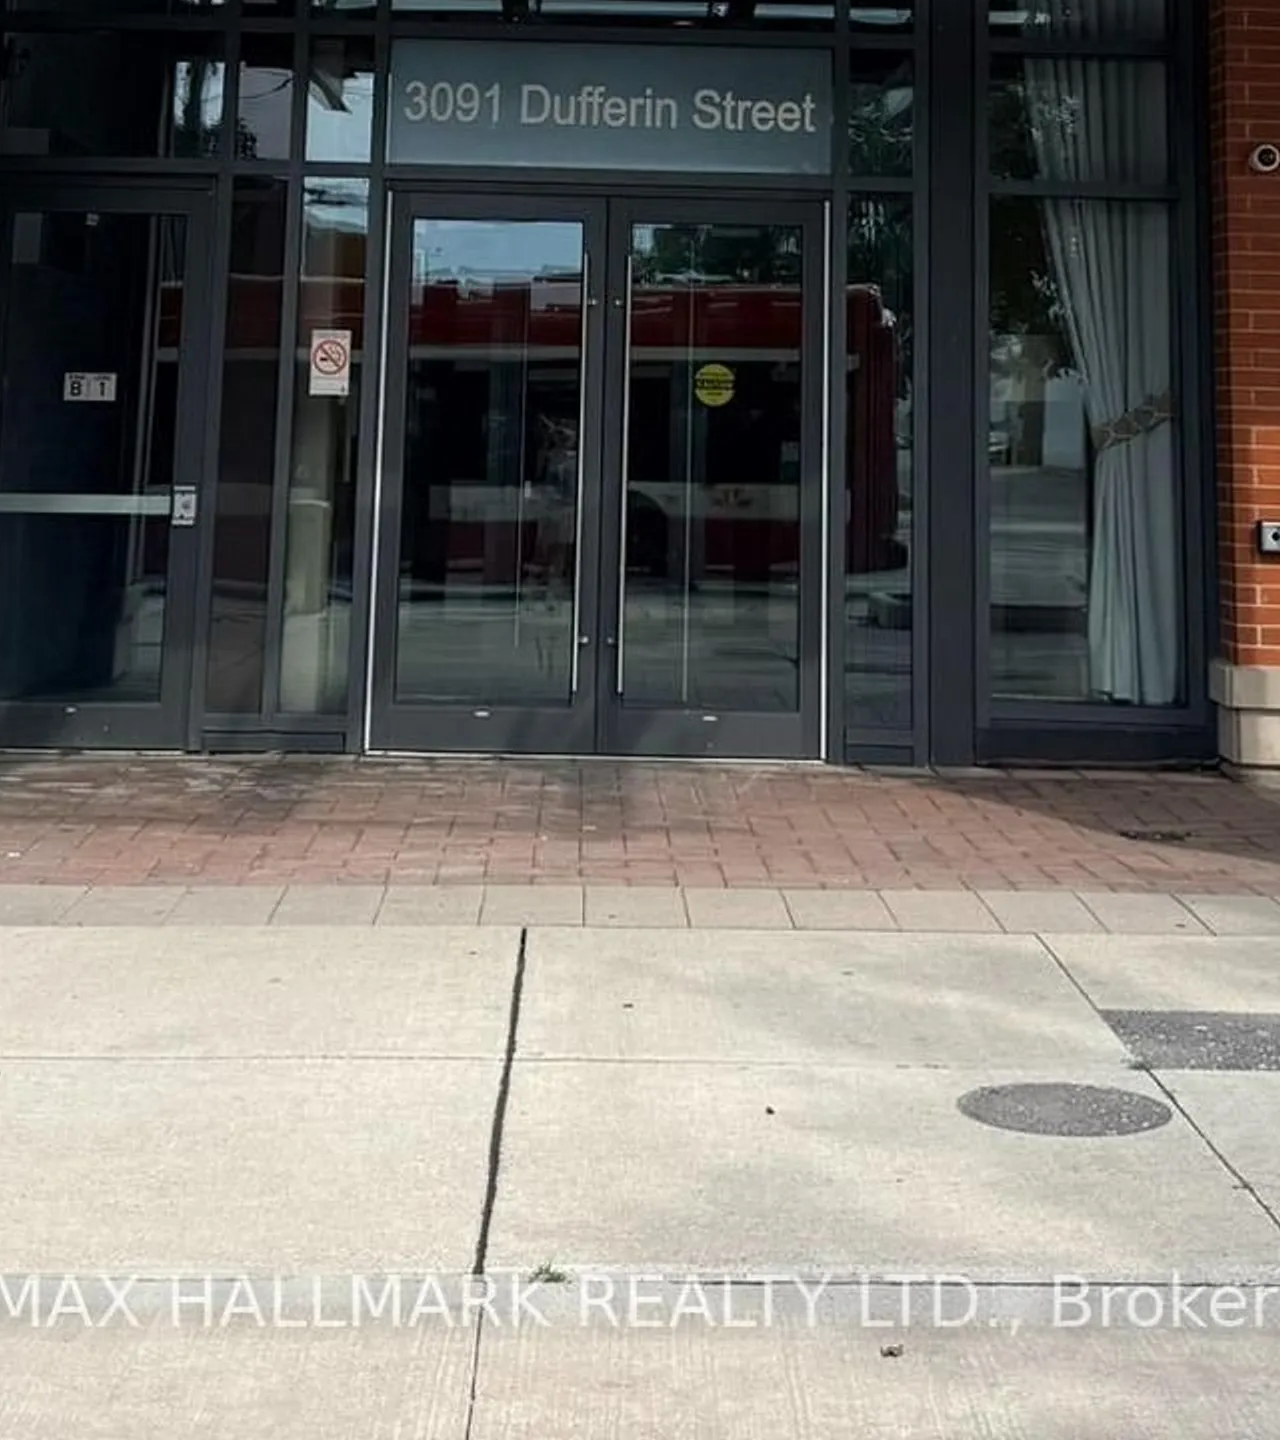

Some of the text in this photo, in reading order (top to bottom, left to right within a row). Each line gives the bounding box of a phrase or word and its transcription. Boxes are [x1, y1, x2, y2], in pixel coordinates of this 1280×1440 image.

[403, 81, 817, 133] 3091 Dufferin Street
